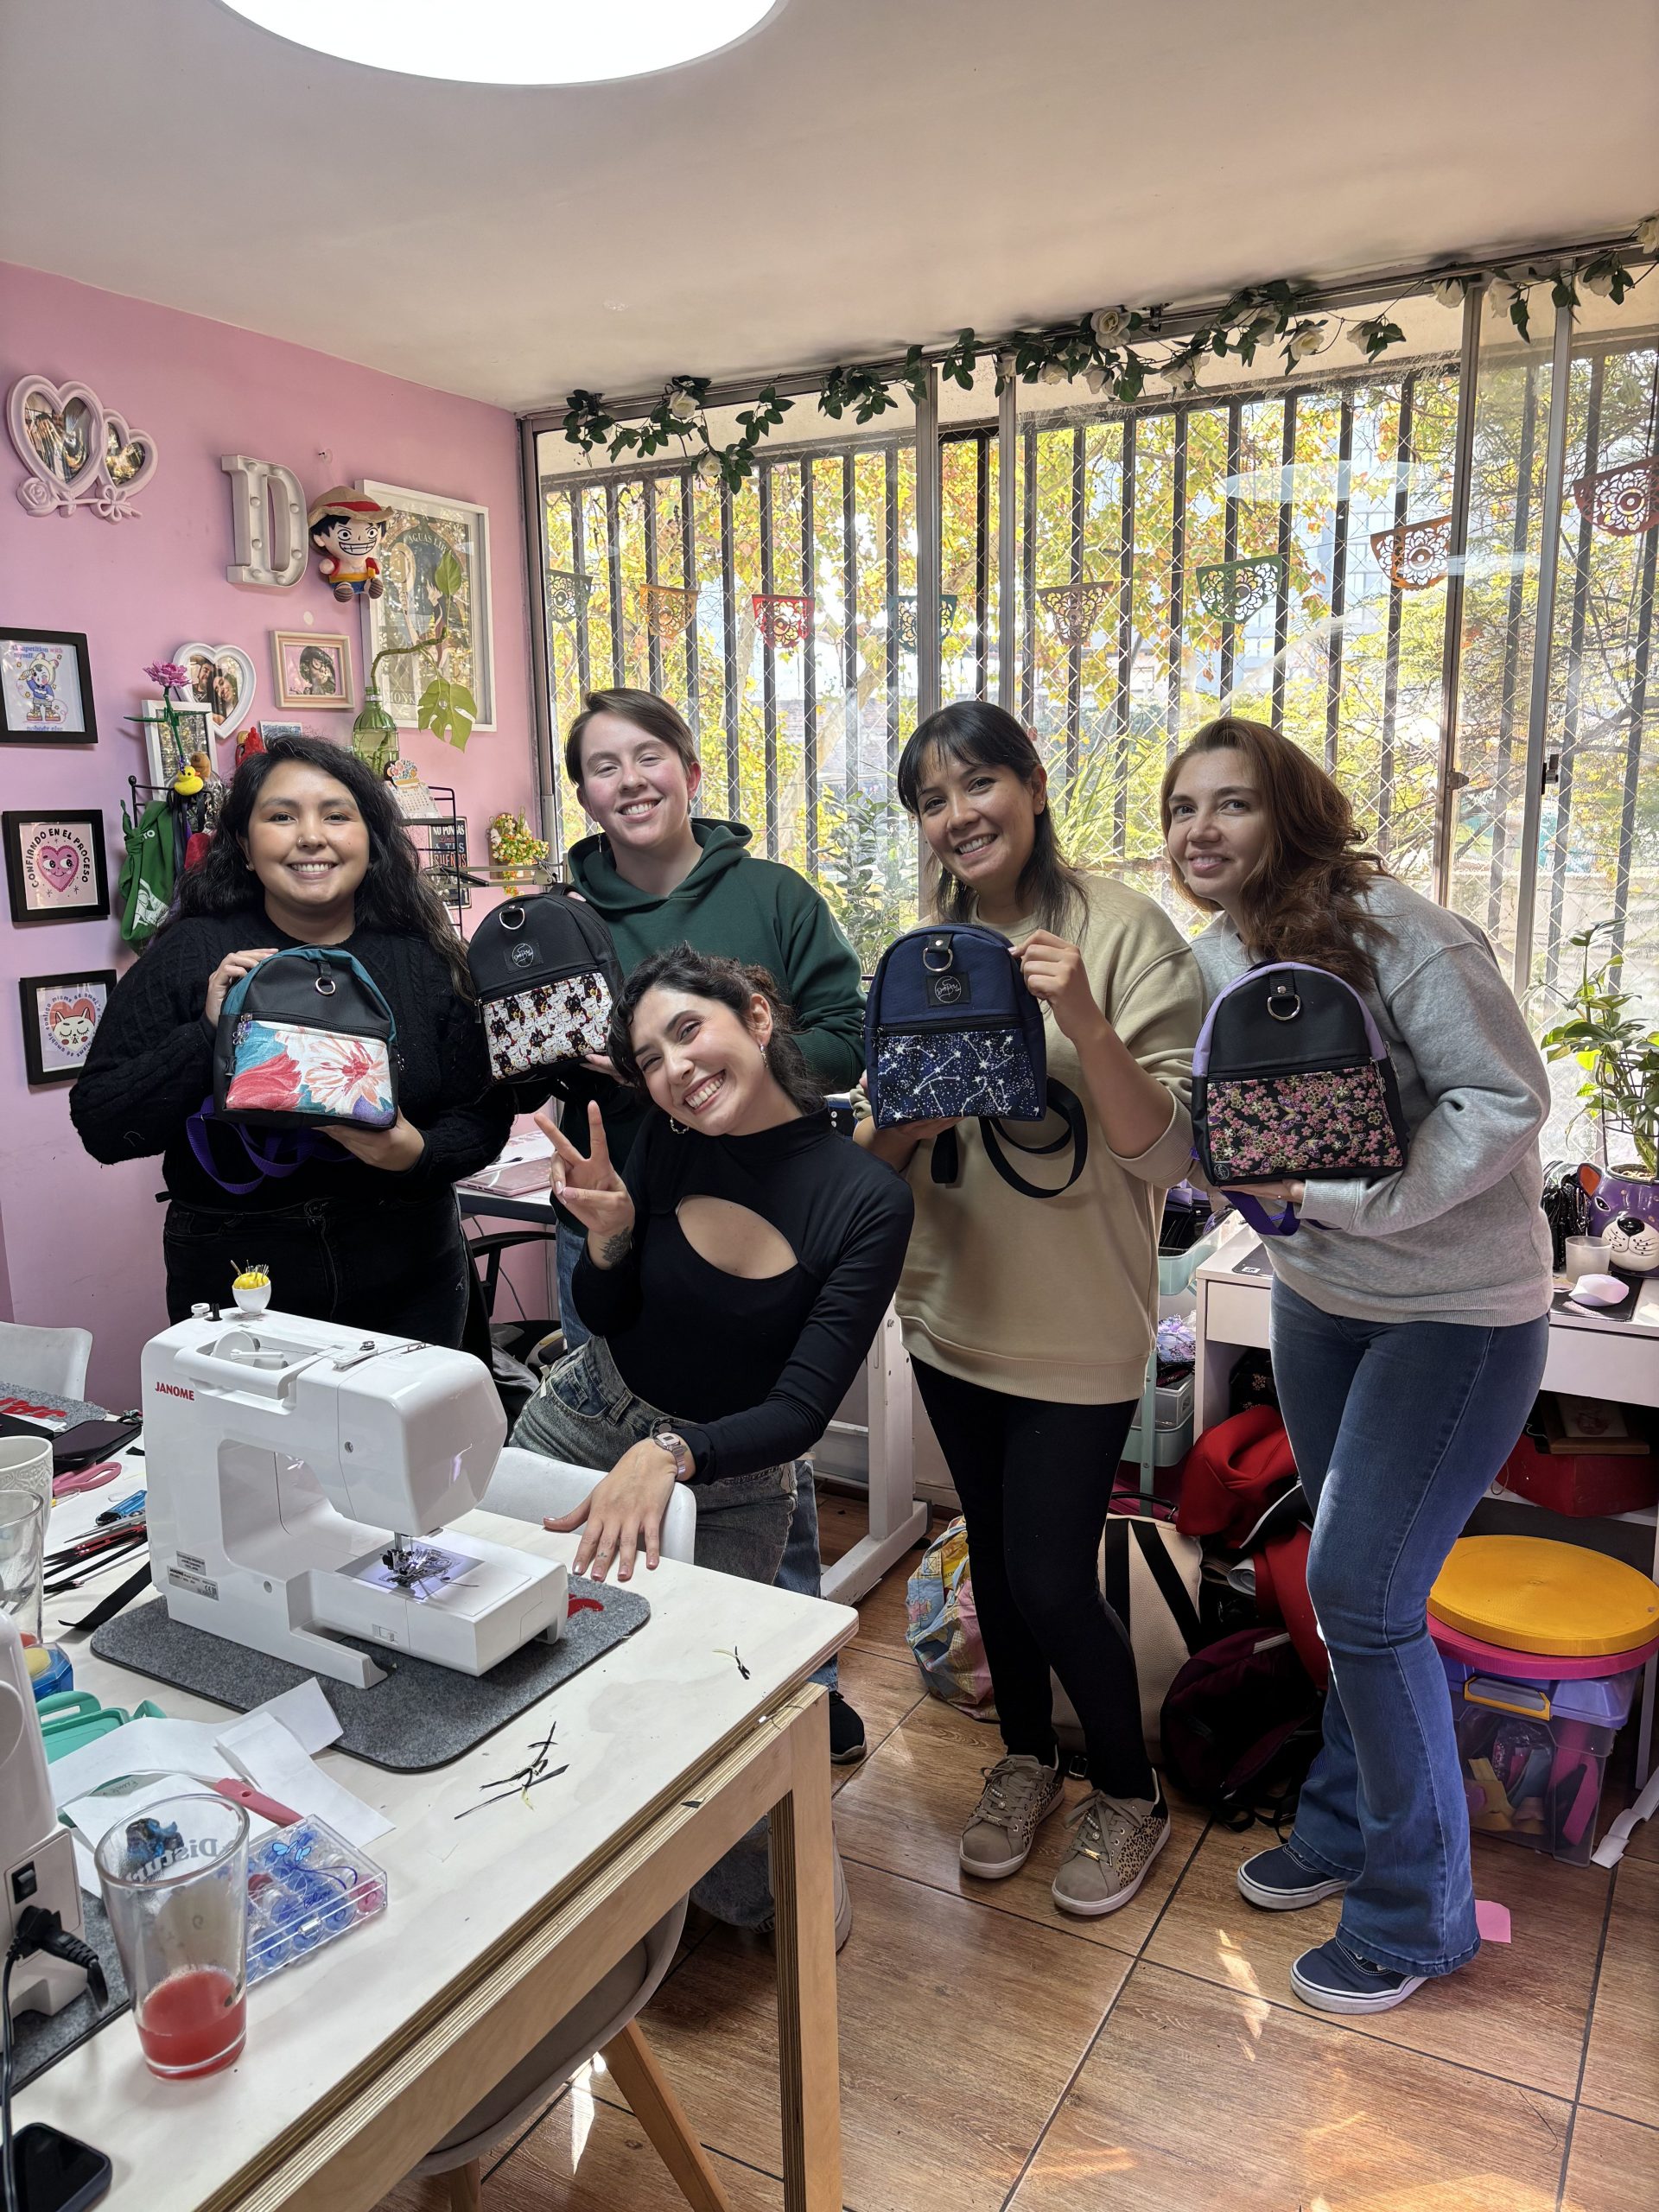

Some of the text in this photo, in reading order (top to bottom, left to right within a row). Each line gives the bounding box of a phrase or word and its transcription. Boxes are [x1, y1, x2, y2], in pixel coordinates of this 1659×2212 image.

[221, 454, 309, 588] D
[26, 831, 47, 888] CONFIANDO
[62, 830, 72, 840] EL
[73, 837, 90, 883] PROCESO
[155, 1382, 194, 1401] JANOME
